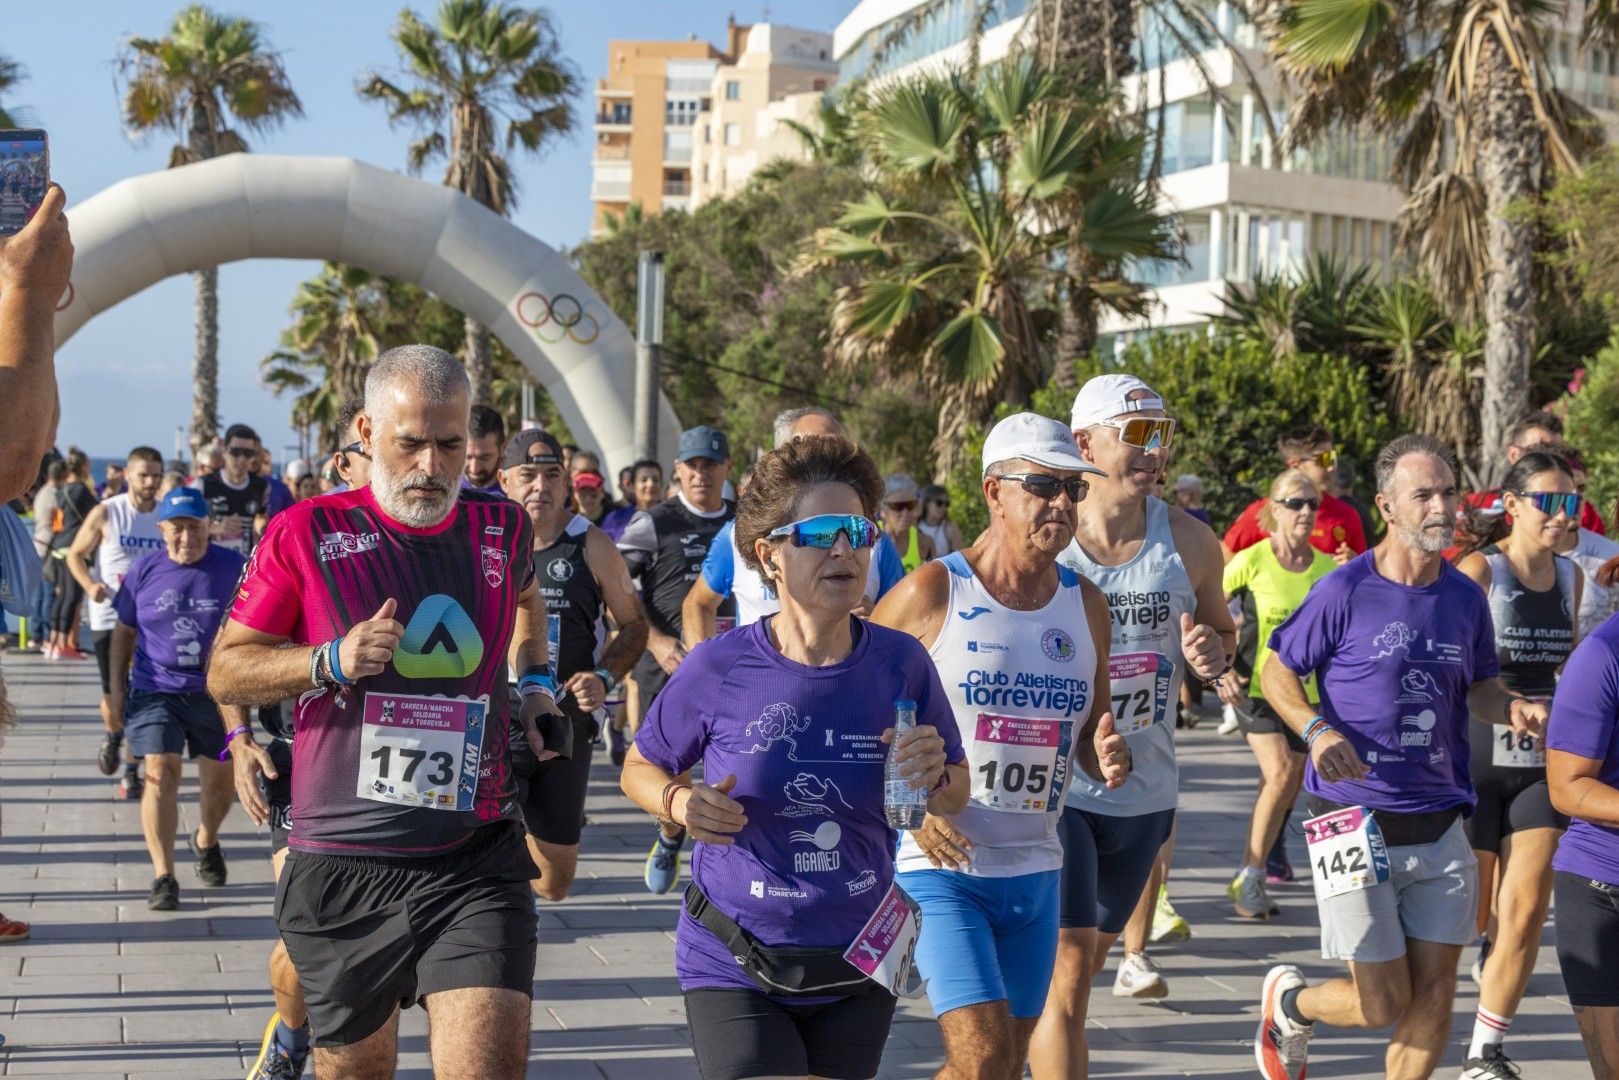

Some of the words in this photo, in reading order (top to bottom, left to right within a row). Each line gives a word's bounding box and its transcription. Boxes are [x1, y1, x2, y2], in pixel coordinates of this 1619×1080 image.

[1504, 627, 1531, 637] CLUB
[967, 669, 1009, 686] Club
[1013, 672, 1088, 692] Atletismo
[1157, 677, 1169, 699] KM
[401, 702, 454, 713] CARRERA/MARCHA
[958, 683, 1087, 717] Torrevieja
[1112, 689, 1151, 719] 72
[412, 711, 442, 719] SOLIDARIA
[416, 719, 451, 728] TORREVIEJA
[1007, 722, 1051, 731] CARRERA/MARCHA
[1401, 731, 1432, 746] AGAMED
[1501, 730, 1534, 752] 18
[371, 745, 454, 786] 173
[463, 743, 479, 777] KM
[1054, 754, 1067, 783] KM
[979, 760, 1049, 794] 105
[1051, 787, 1062, 799] 7
[1369, 834, 1385, 857] KM
[794, 850, 840, 873] AGAMED
[1317, 846, 1368, 880] 142
[1376, 861, 1388, 871] 7
[768, 889, 807, 898] TORREVIEJA
[868, 897, 898, 938] CARRERA/MARCHA
[880, 911, 898, 934] SOLIDARIA
